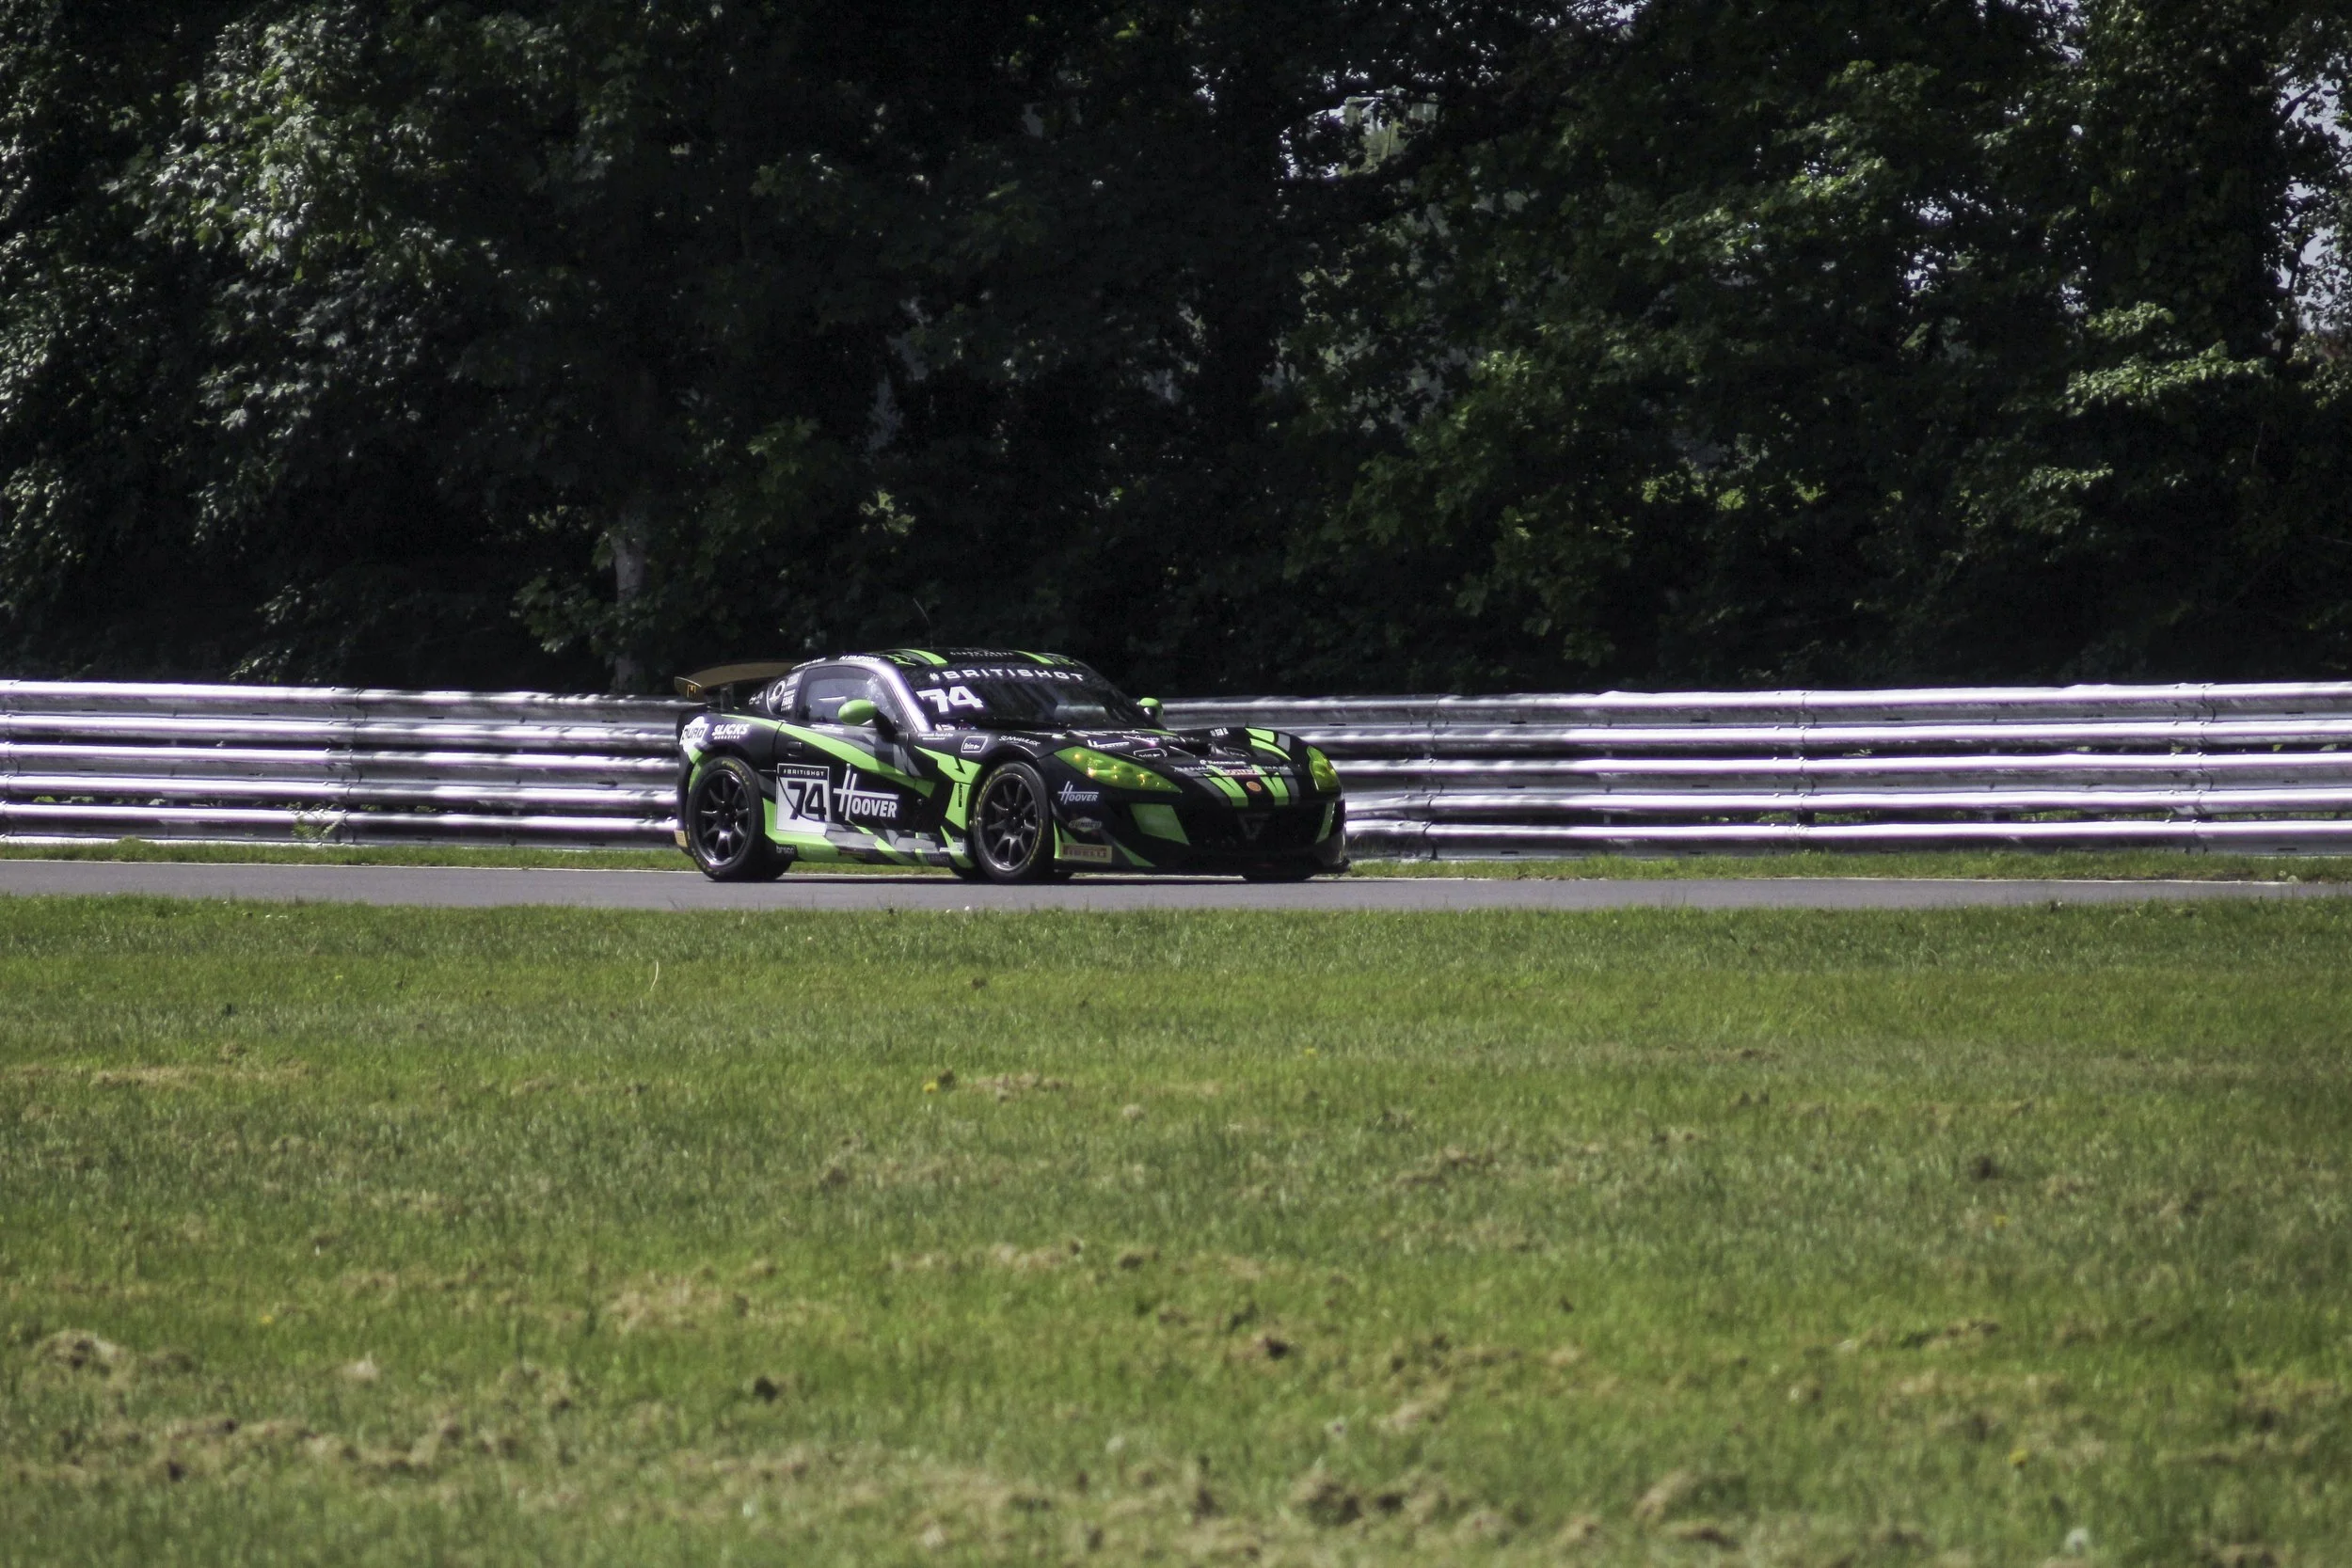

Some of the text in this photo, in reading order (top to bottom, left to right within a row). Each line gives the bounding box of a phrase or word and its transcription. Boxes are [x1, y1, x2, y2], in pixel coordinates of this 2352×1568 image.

[929, 668, 1084, 682] #BRITISHGT
[915, 686, 984, 714] 74
[711, 723, 750, 736] SLICKS
[783, 768, 825, 777] #BRITISHGT
[787, 780, 827, 821] 74
